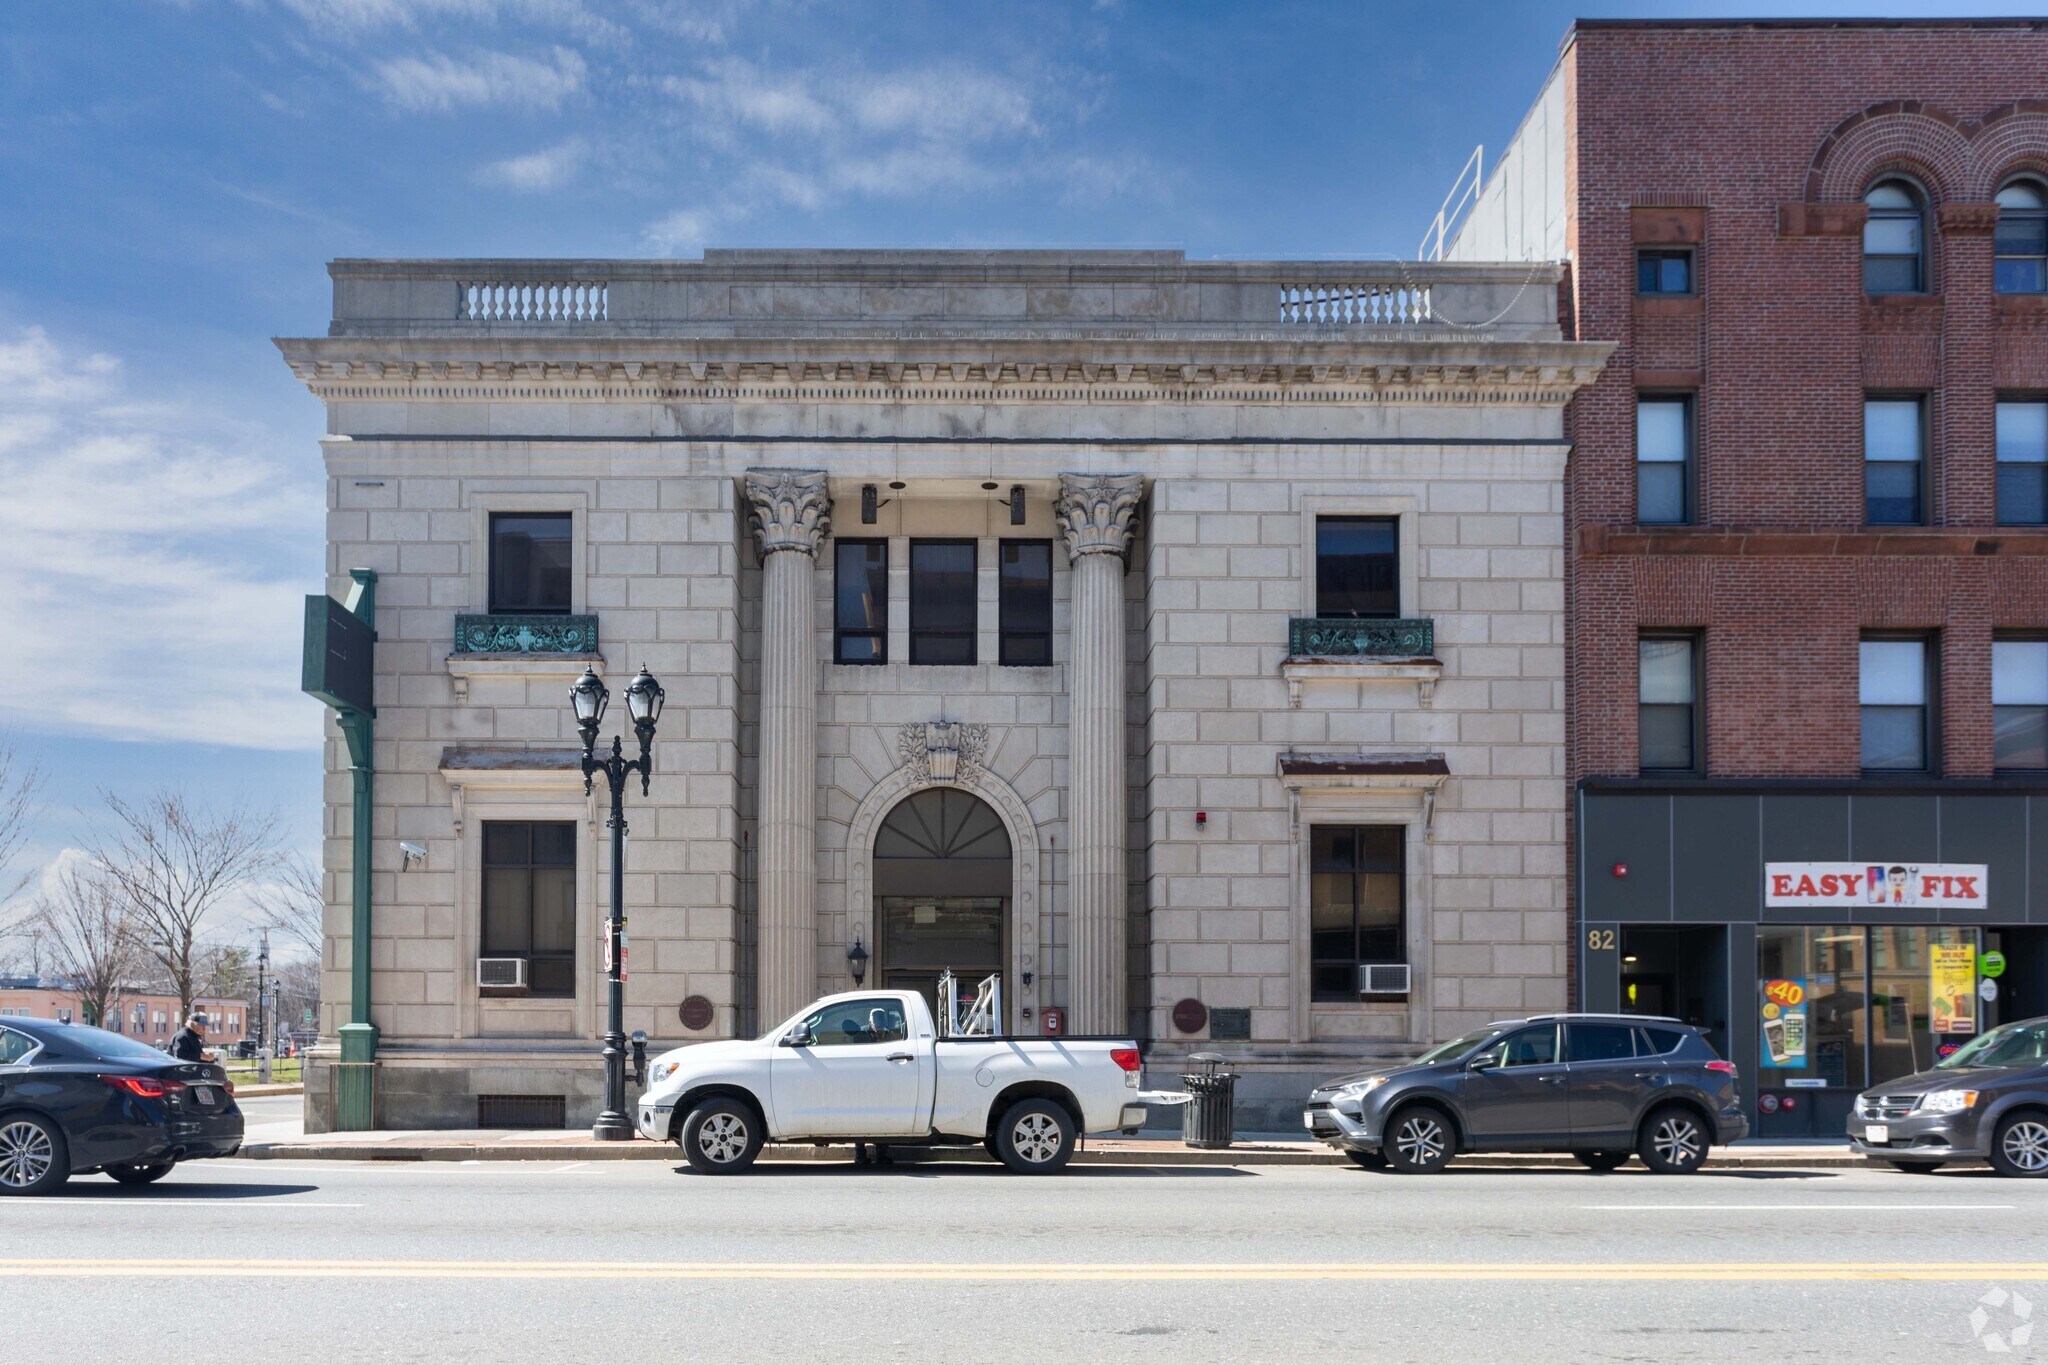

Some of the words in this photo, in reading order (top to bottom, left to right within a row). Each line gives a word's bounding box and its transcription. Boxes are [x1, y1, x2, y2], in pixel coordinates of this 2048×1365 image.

[1772, 874, 1864, 897] EASY
[1921, 876, 1979, 898] FIX
[1588, 930, 1615, 950] 82
[1766, 981, 1804, 1005] $40
